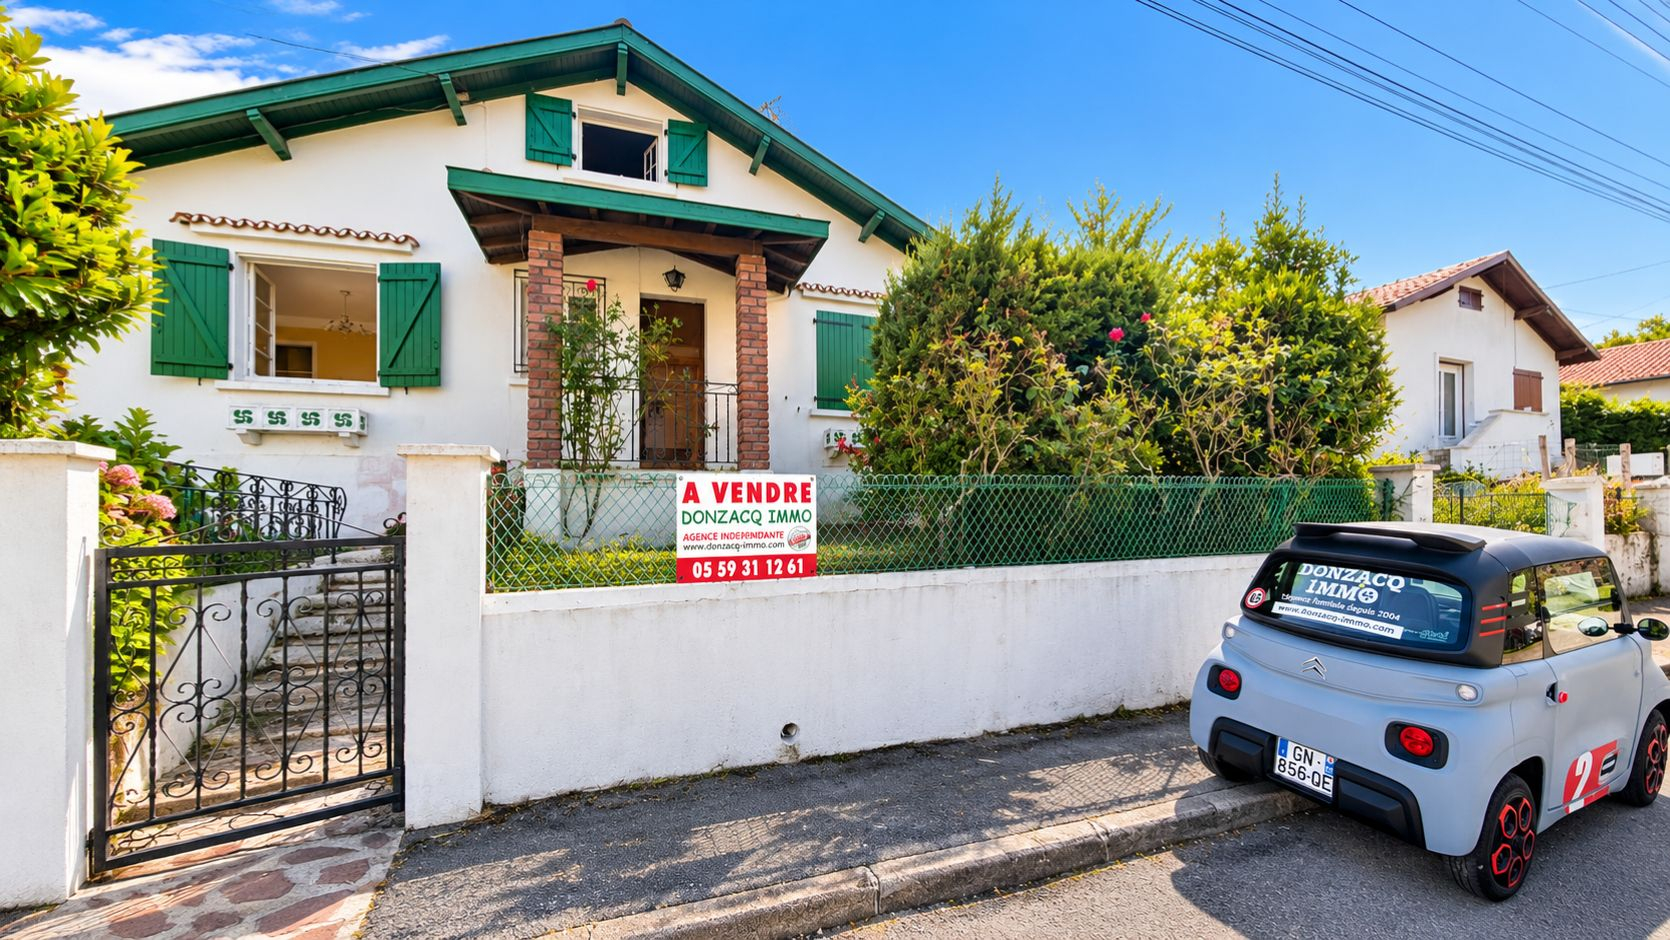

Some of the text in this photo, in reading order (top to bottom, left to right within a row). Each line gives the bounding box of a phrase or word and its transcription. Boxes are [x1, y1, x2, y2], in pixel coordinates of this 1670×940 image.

[682, 481, 812, 504] A VENDRE
[681, 509, 812, 526] DONZACQ IMMO
[682, 532, 718, 542] AGENCE
[683, 541, 785, 552] www.donzacq-immo.com
[692, 558, 804, 579] 05 59 31 12 61
[1297, 563, 1405, 593] DONZACQ
[1305, 579, 1379, 604] IMMO
[1377, 610, 1401, 621] 2004
[1277, 758, 1333, 793] 856-QE
